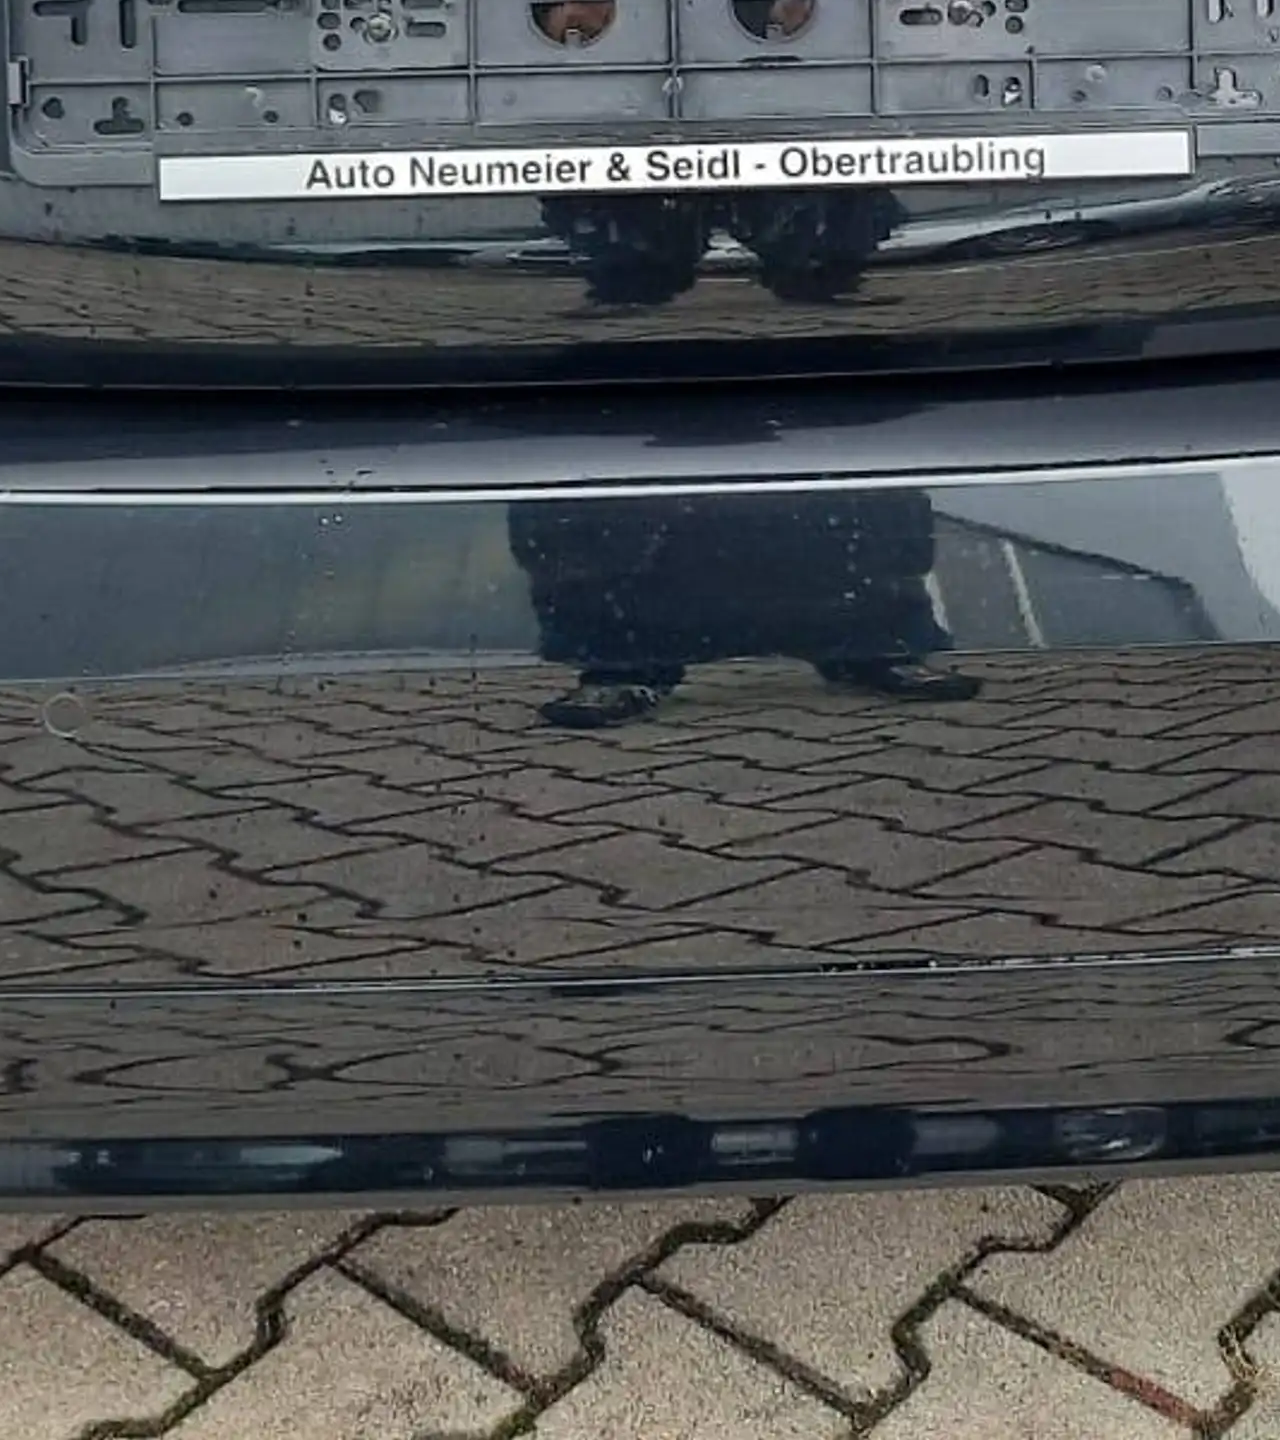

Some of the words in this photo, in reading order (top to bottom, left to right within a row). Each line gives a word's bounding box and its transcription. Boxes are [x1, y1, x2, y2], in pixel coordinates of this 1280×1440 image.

[306, 160, 395, 190] Auto
[409, 154, 592, 187] Neumeier
[606, 151, 631, 181] &
[646, 149, 741, 181] Seidl
[779, 142, 1046, 182] Obertraubling
